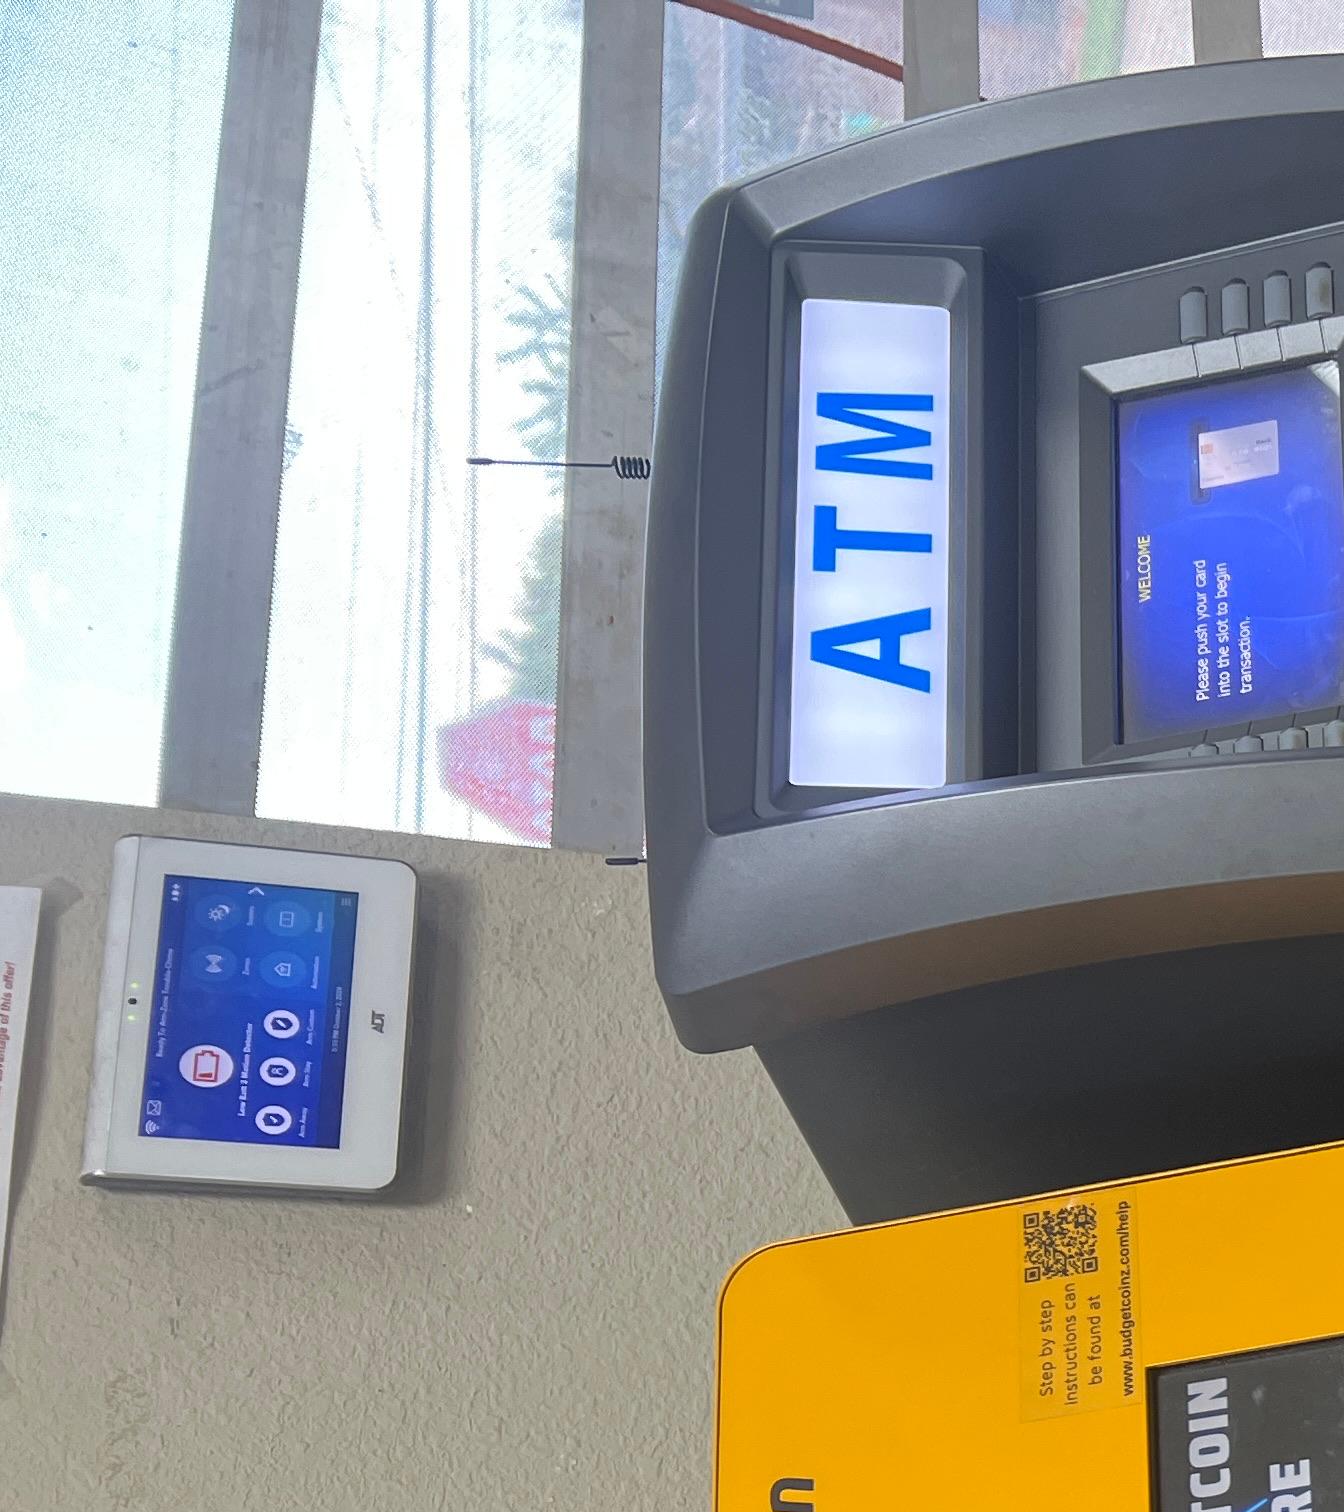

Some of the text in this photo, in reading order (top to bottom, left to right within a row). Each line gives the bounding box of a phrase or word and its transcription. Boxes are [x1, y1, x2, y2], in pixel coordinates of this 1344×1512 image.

[811, 392, 933, 693] ATM
[1137, 534, 1151, 604] WELCOME
[1193, 559, 1212, 702] Please push your card
[1214, 562, 1231, 697] into the slot to begin
[1238, 615, 1252, 694] transaction.
[2, 992, 12, 1012] this
[4, 961, 15, 990] offer!
[370, 1009, 385, 1034] ADT
[1064, 1283, 1077, 1310] can
[1115, 1200, 1134, 1396] www.budgetcoinz.com/help
[1038, 1300, 1056, 1397] Step by step
[1087, 1294, 1103, 1385] be found at
